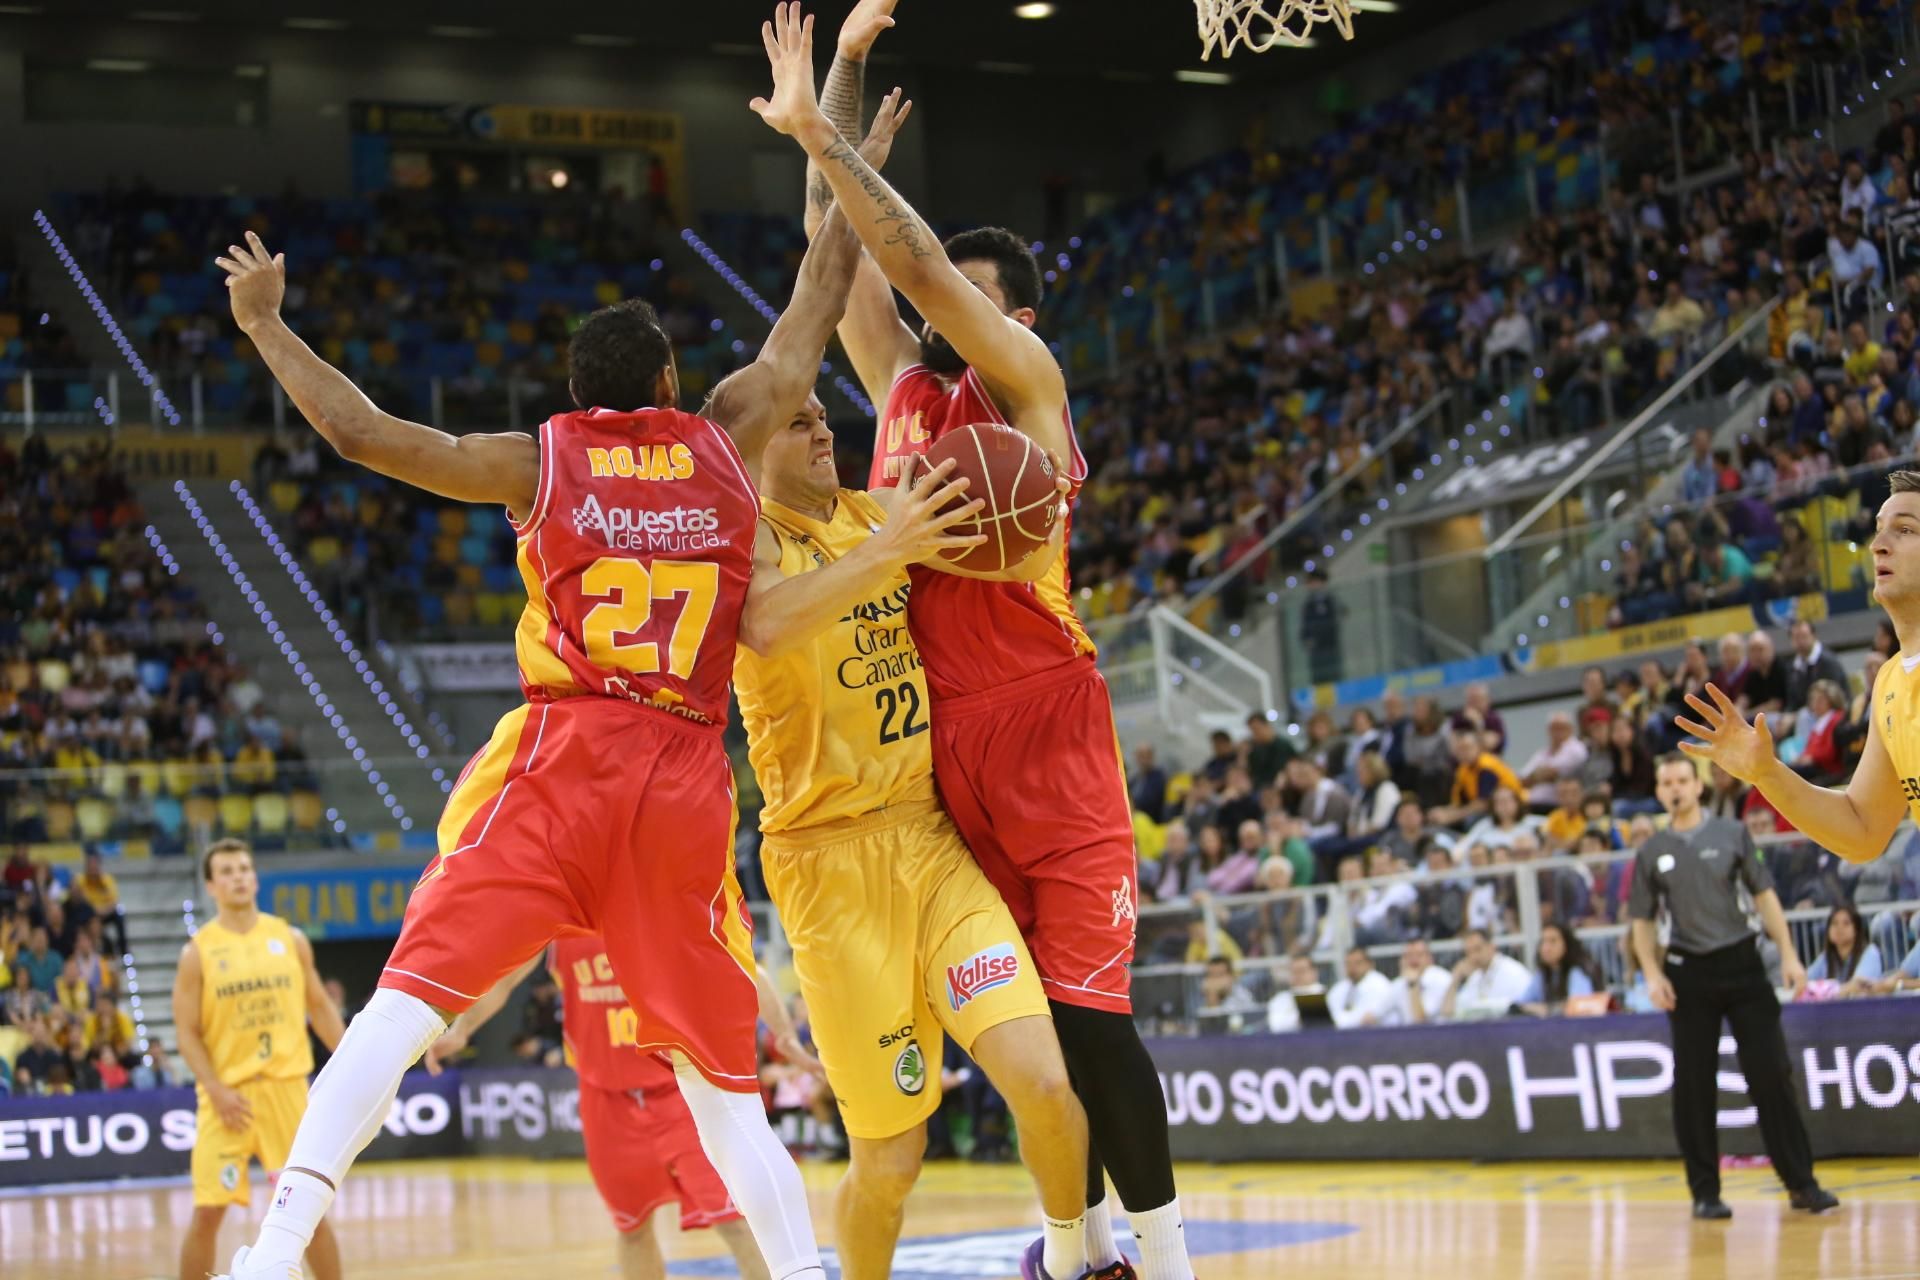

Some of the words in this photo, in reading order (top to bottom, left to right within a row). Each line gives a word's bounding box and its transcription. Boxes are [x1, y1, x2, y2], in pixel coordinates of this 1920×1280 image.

[586, 443, 694, 481] ROJAS
[572, 494, 719, 549] Apuestas
[616, 528, 643, 549] de
[581, 556, 720, 680] 27
[875, 681, 930, 746] 22
[273, 882, 358, 924] GRAN
[947, 954, 1018, 1012] Kalise
[257, 1031, 273, 1061] 3
[606, 1007, 638, 1049] 10
[458, 1080, 547, 1142] HPS
[1229, 1061, 1490, 1125] SOCORRO
